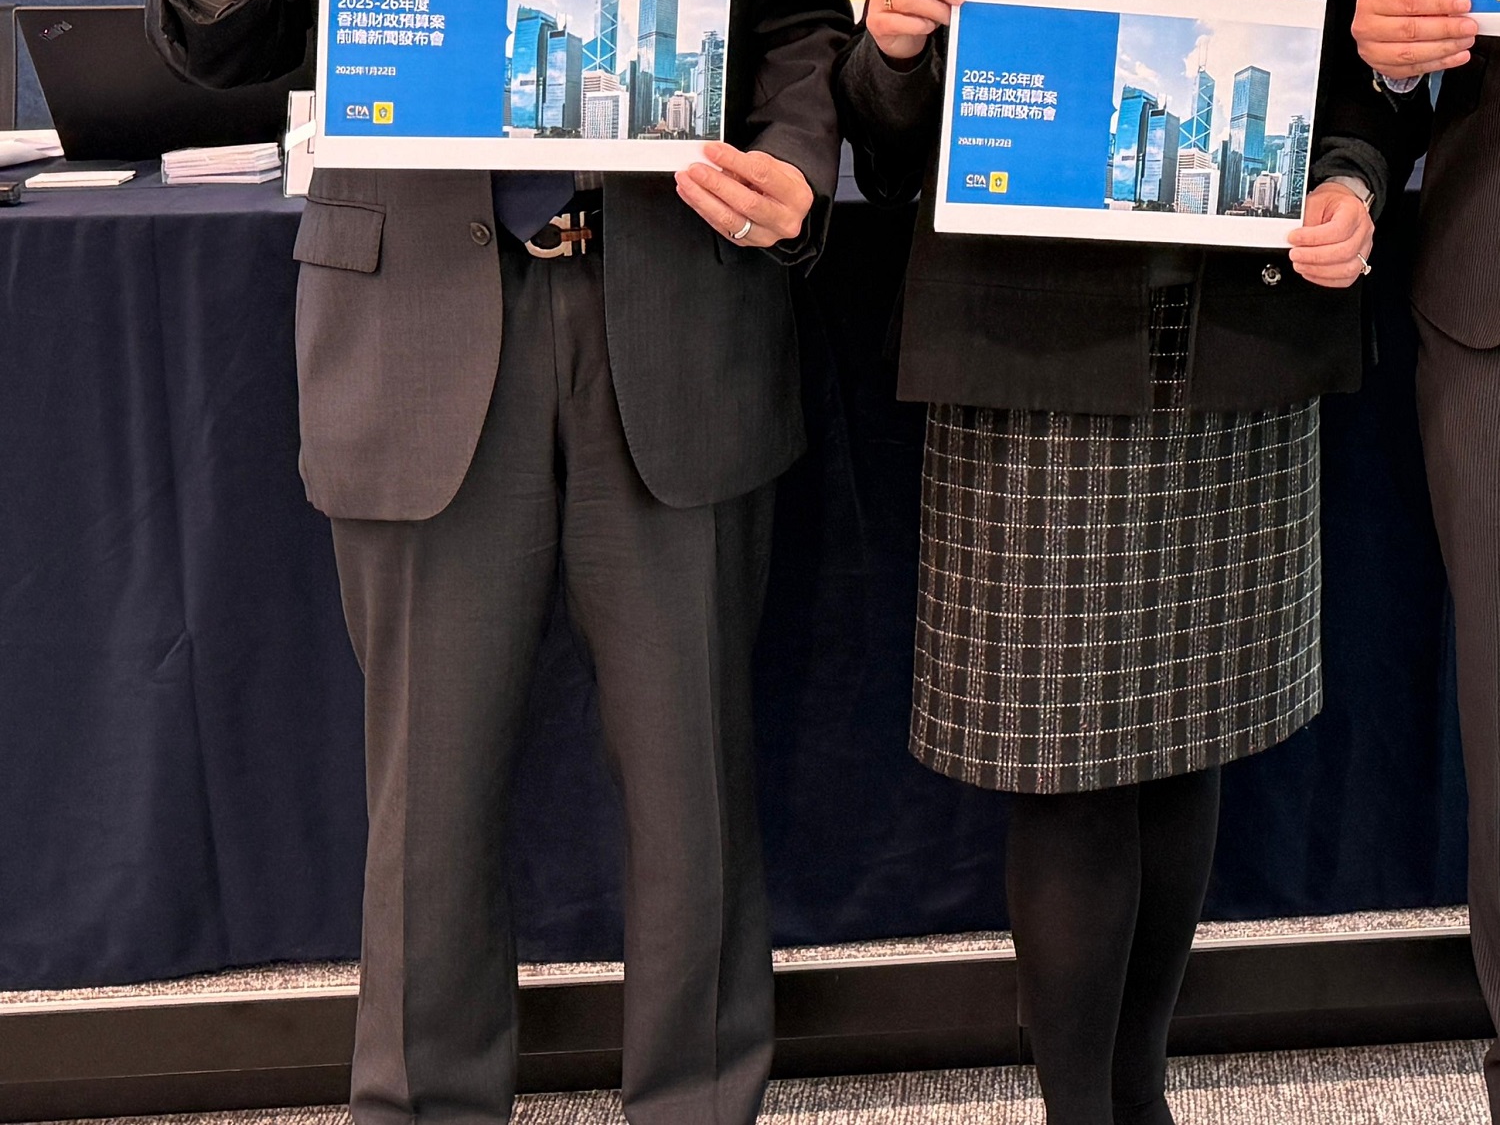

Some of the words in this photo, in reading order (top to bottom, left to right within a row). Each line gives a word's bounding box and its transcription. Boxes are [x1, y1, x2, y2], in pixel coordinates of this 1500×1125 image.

[337, 11, 445, 29] 香港財政預算案
[962, 70, 1045, 88] 2025-26年度
[961, 85, 1057, 105] 香港財政預算案
